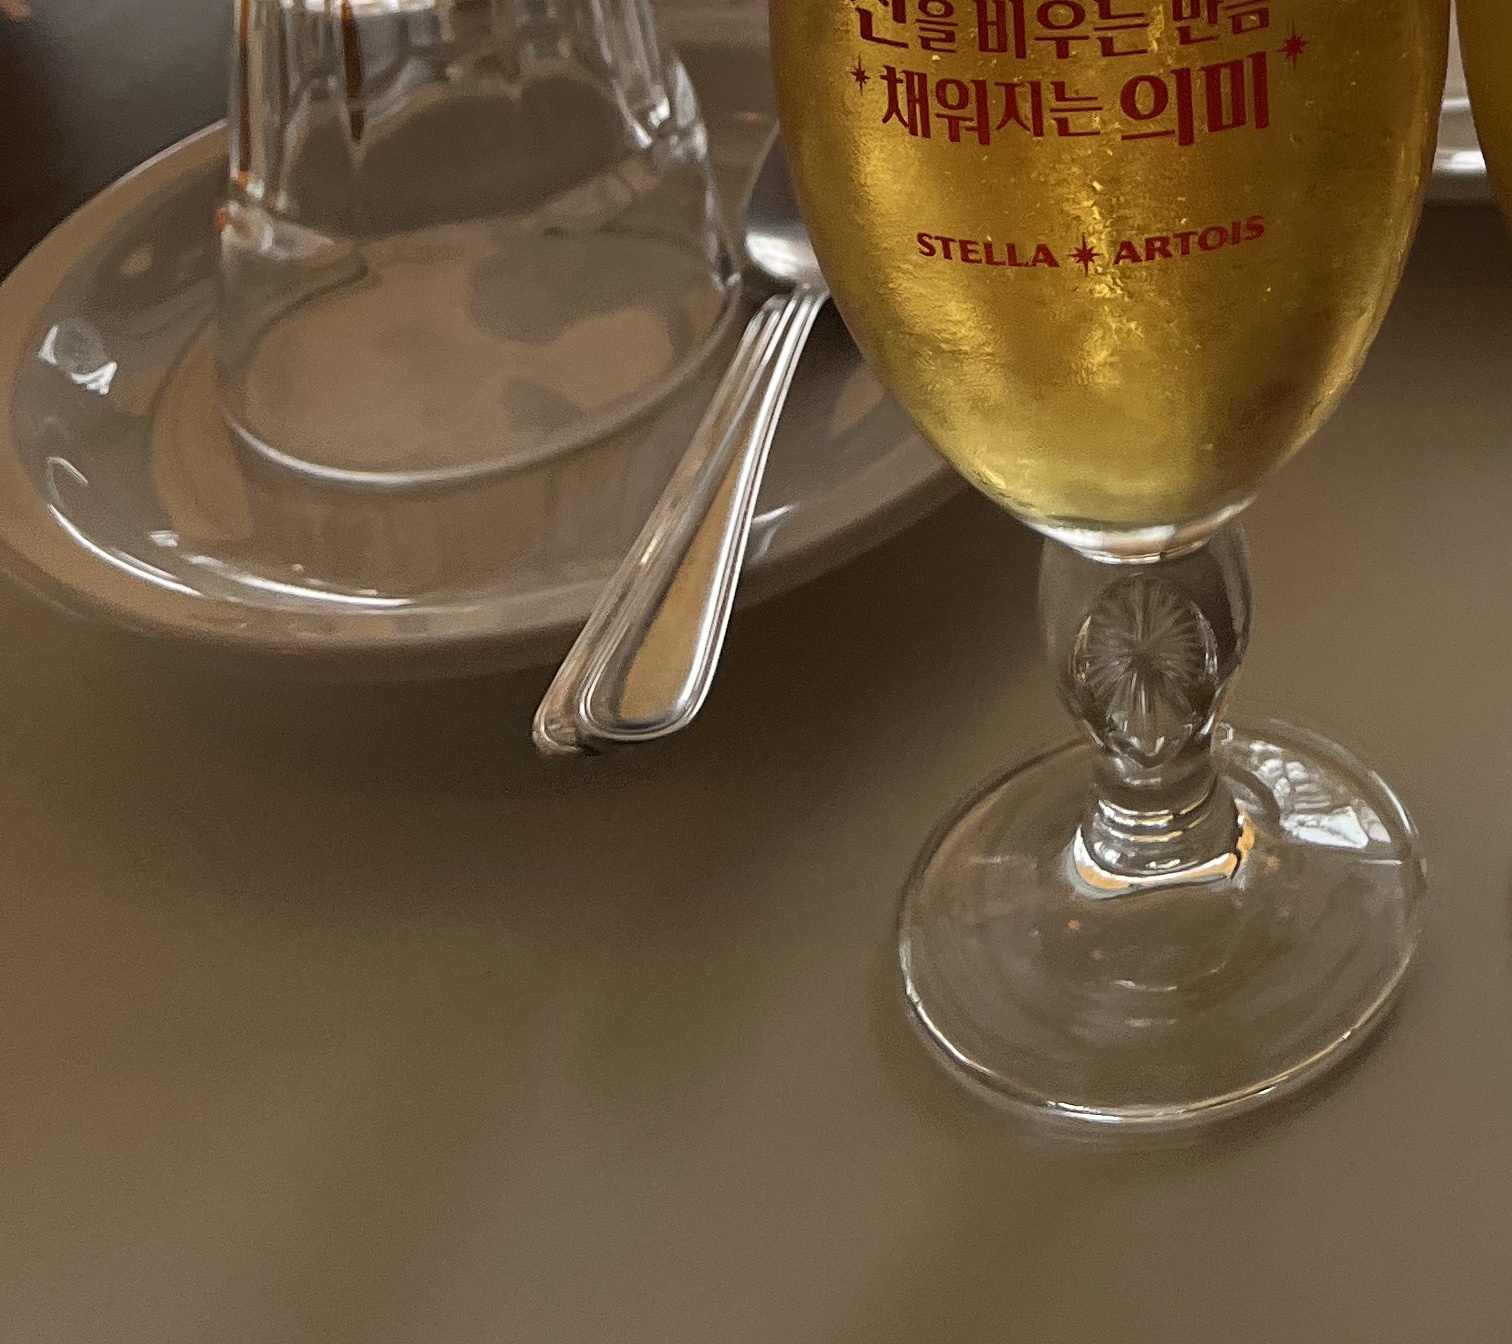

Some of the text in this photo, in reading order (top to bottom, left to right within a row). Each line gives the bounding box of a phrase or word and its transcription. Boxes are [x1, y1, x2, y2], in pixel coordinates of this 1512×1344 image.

[880, 50, 1270, 147] 채워지는 의미
[916, 214, 1266, 269] STELLA ARTOIS
